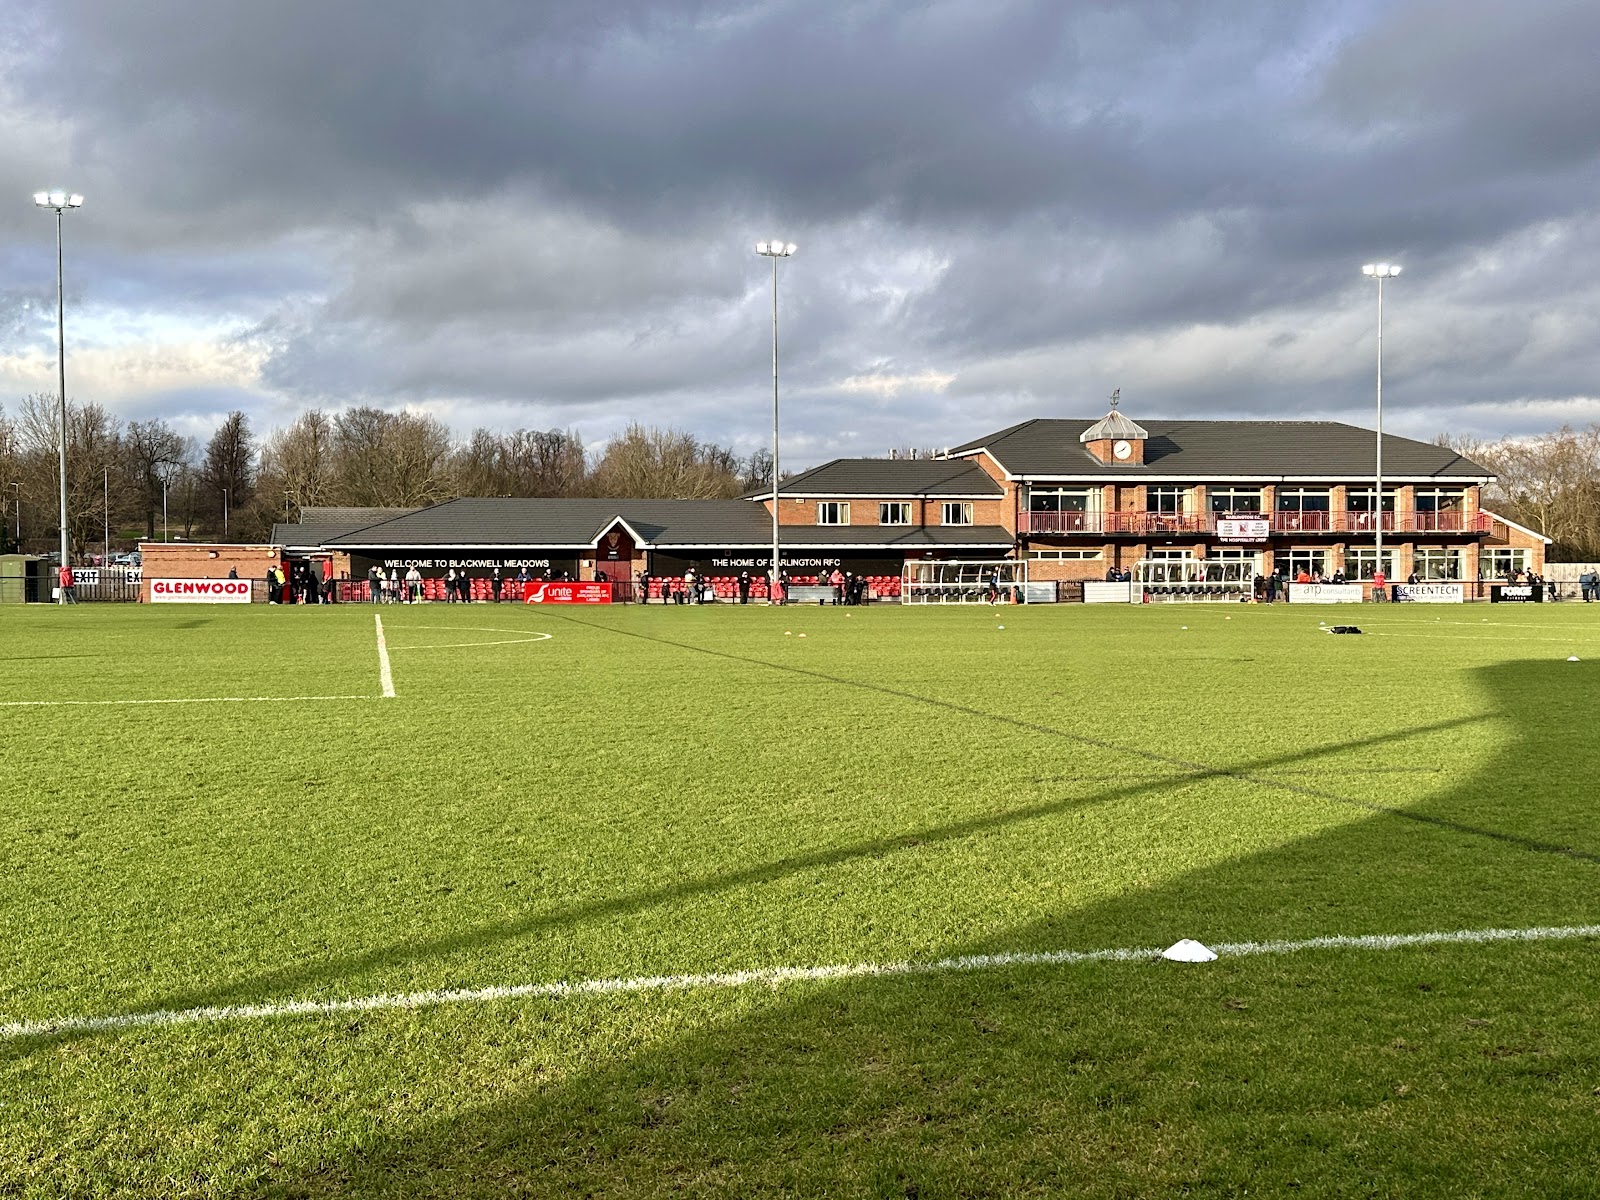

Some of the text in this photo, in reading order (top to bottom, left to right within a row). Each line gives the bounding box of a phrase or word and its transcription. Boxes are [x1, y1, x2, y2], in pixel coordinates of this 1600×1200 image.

[384, 560, 550, 568] WELCOME TO BLACKWELL MEADOWS
[74, 572, 97, 582] EXIT
[127, 572, 142, 582] EX
[154, 582, 248, 594] GLENWOOD
[548, 587, 572, 596] unite
[1396, 586, 1458, 595] SCREENTECH
[1500, 586, 1532, 596] FORGE
